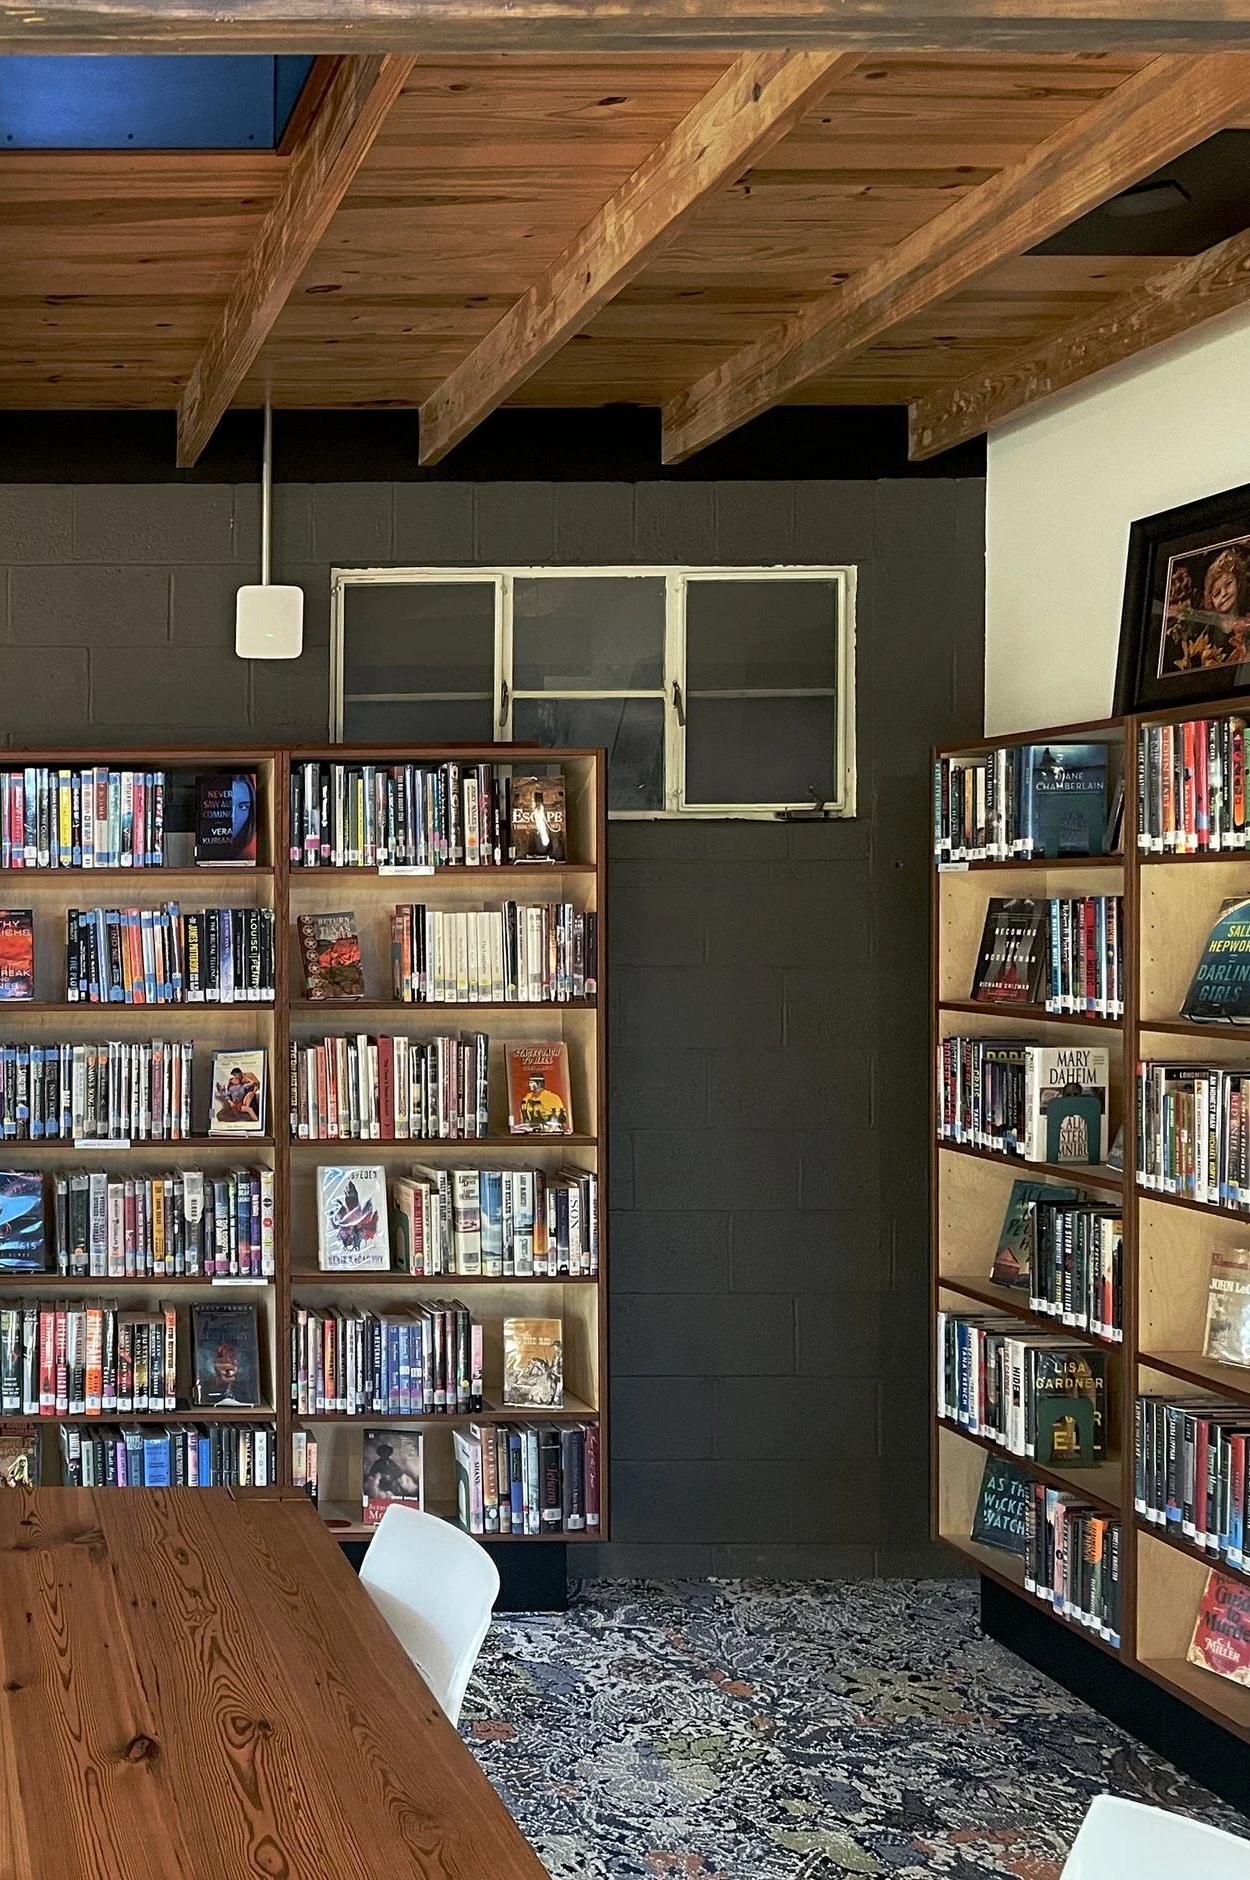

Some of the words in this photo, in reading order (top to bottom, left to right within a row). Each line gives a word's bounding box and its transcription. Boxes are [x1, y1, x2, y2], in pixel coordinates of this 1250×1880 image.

[1057, 772, 1084, 780] DANE
[1036, 782, 1104, 790] CHAMBERLAIN
[207, 790, 233, 799] NEVER
[202, 810, 233, 819] COMING
[512, 808, 563, 823] ESCPE
[211, 828, 233, 836] VERA
[202, 837, 233, 845] KURIAN
[188, 924, 198, 942] JAMES
[250, 918, 258, 951] LOUISE
[995, 928, 1037, 936] BECOMING
[1228, 925, 1250, 938] SALL
[1209, 940, 1250, 952] HEPWOR
[111, 948, 118, 963] ME
[188, 943, 198, 973] PATTERSON
[984, 953, 1036, 963] BOOGEYMAN
[250, 959, 258, 989] PENNY
[1196, 964, 1250, 982] DARLIN
[1198, 985, 1242, 1001] GIRLS
[1057, 1050, 1091, 1067] MARY
[1049, 1068, 1097, 1084] DAHEIM
[1209, 1076, 1216, 1085] AN
[87, 1090, 95, 1105] SONG
[1231, 1095, 1239, 1116] RED
[1231, 1121, 1239, 1151] KNIFE
[570, 1200, 578, 1229] SON
[1209, 1279, 1233, 1292] JOHN
[1054, 1361, 1086, 1374] LISA
[1035, 1378, 1104, 1389] GARDNER
[987, 1476, 1005, 1491] AS
[984, 1492, 1025, 1516] WICKE
[1205, 1638, 1241, 1663] MILLER
